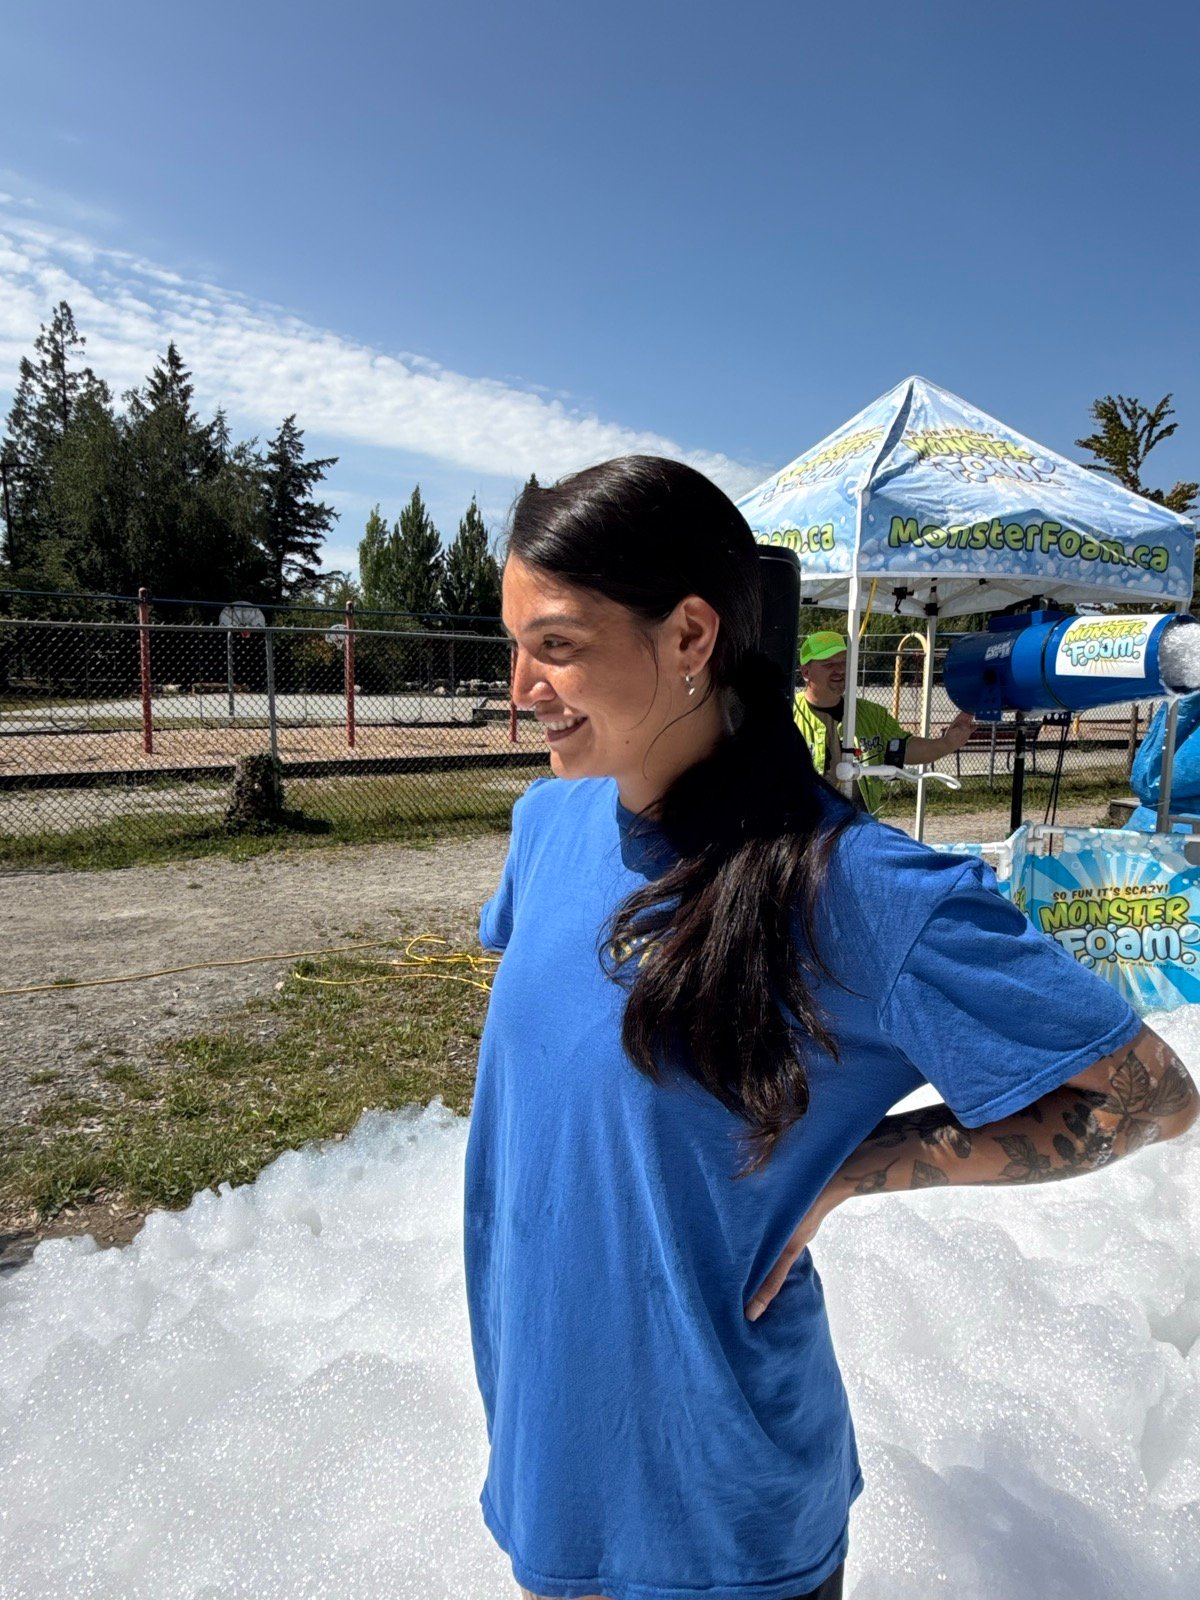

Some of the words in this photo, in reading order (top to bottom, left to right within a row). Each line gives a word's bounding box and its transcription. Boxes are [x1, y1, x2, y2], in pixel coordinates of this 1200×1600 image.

[888, 516, 1169, 573] MonsterFoam.ca
[1065, 621, 1148, 645] MONSTER
[1053, 891, 1067, 901] SO
[1071, 889, 1093, 900] FUN
[1097, 886, 1121, 898] IT'S
[1039, 896, 1190, 933] MONSTER
